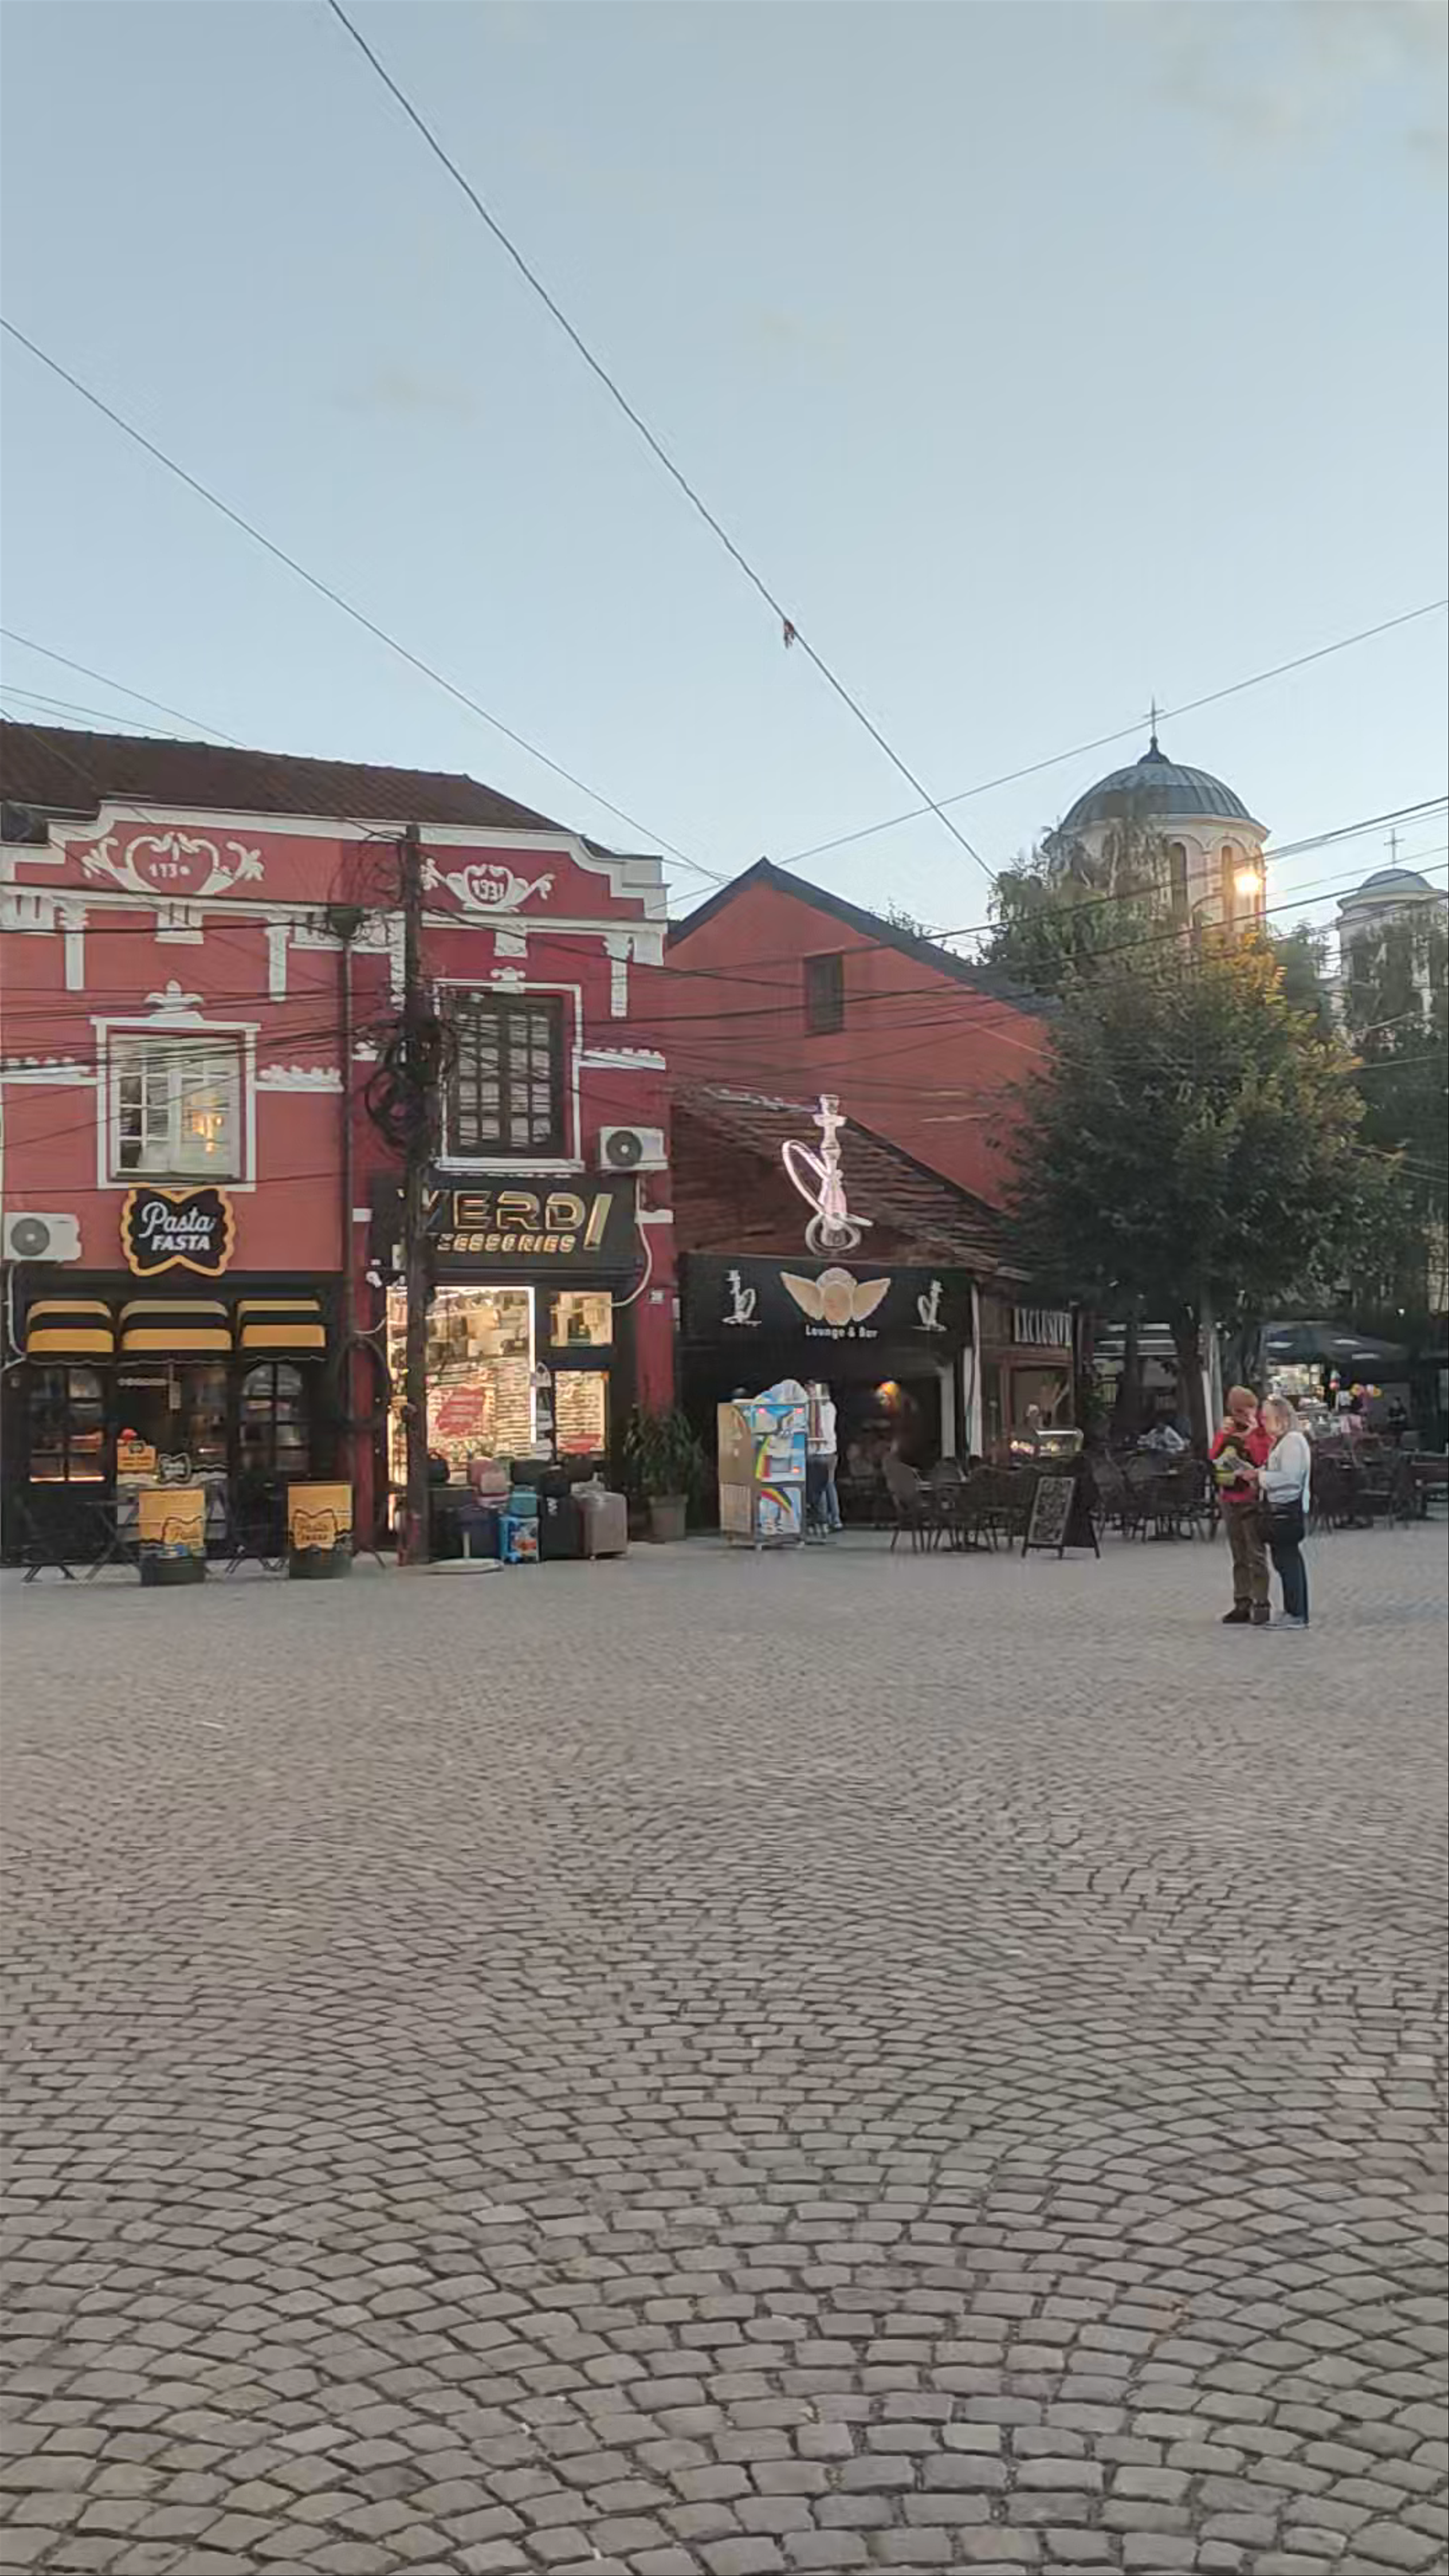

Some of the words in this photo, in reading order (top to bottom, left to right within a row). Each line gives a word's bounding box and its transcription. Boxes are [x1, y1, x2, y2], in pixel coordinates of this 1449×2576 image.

[138, 1201, 216, 1238] Pasta
[151, 1235, 210, 1250] FASTA
[805, 1324, 845, 1340] Lounge
[848, 1326, 855, 1338] &
[859, 1326, 878, 1338] Bar
